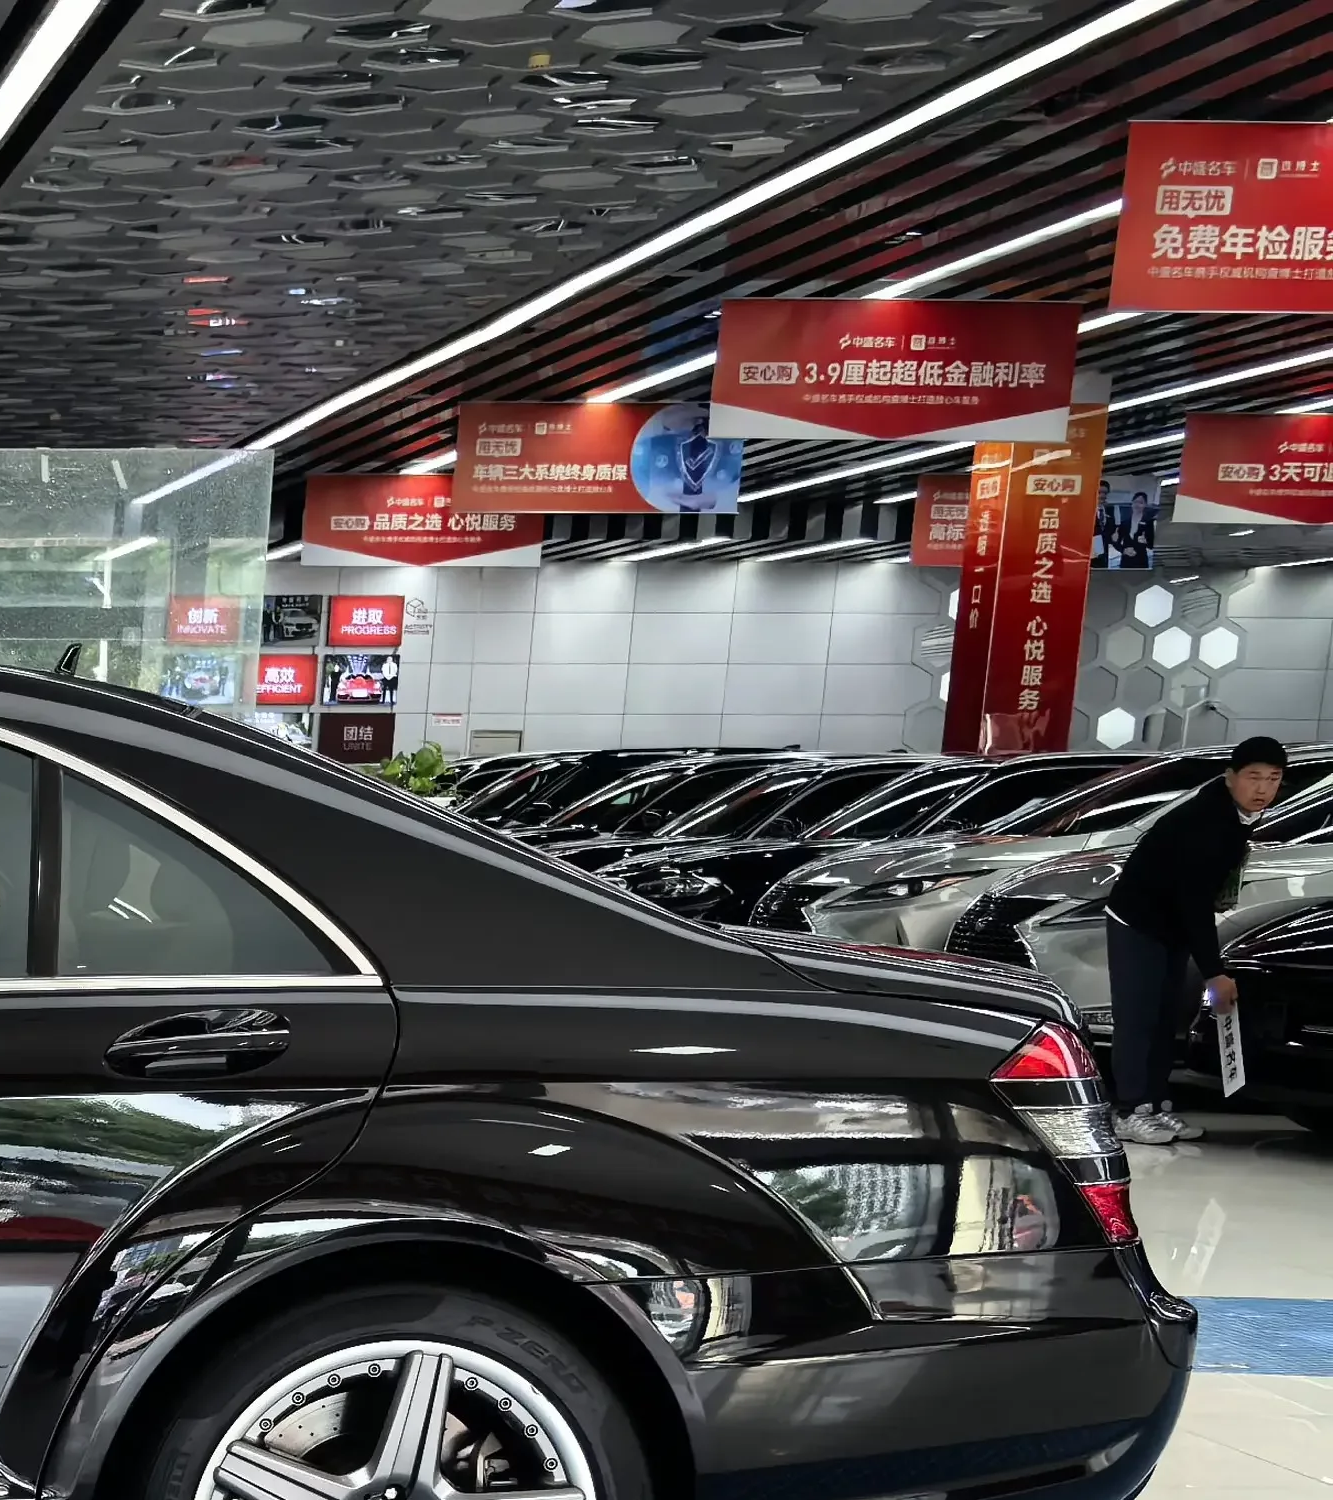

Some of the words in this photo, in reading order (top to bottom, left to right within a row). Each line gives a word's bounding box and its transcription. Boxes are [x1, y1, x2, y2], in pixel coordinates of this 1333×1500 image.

[1160, 189, 1226, 212] 用无忧
[1151, 224, 1333, 261] 免费年检服
[743, 365, 793, 381] 安心购
[804, 359, 1046, 387] 3.9厘起超低金融利率
[473, 464, 628, 481] 车辆三大系统终身质保
[1034, 477, 1076, 492] 安心购
[373, 513, 442, 531] 品质之选
[447, 513, 516, 532] 心悦服务
[1029, 508, 1060, 604] 品质之选
[188, 607, 219, 625] 创新
[352, 608, 384, 625] 进取
[341, 625, 398, 636] PROGRESS
[1018, 615, 1048, 711] 心悦服务
[264, 666, 296, 683] 高效
[256, 684, 303, 694] EFFICIENT
[343, 725, 374, 741] 团结
